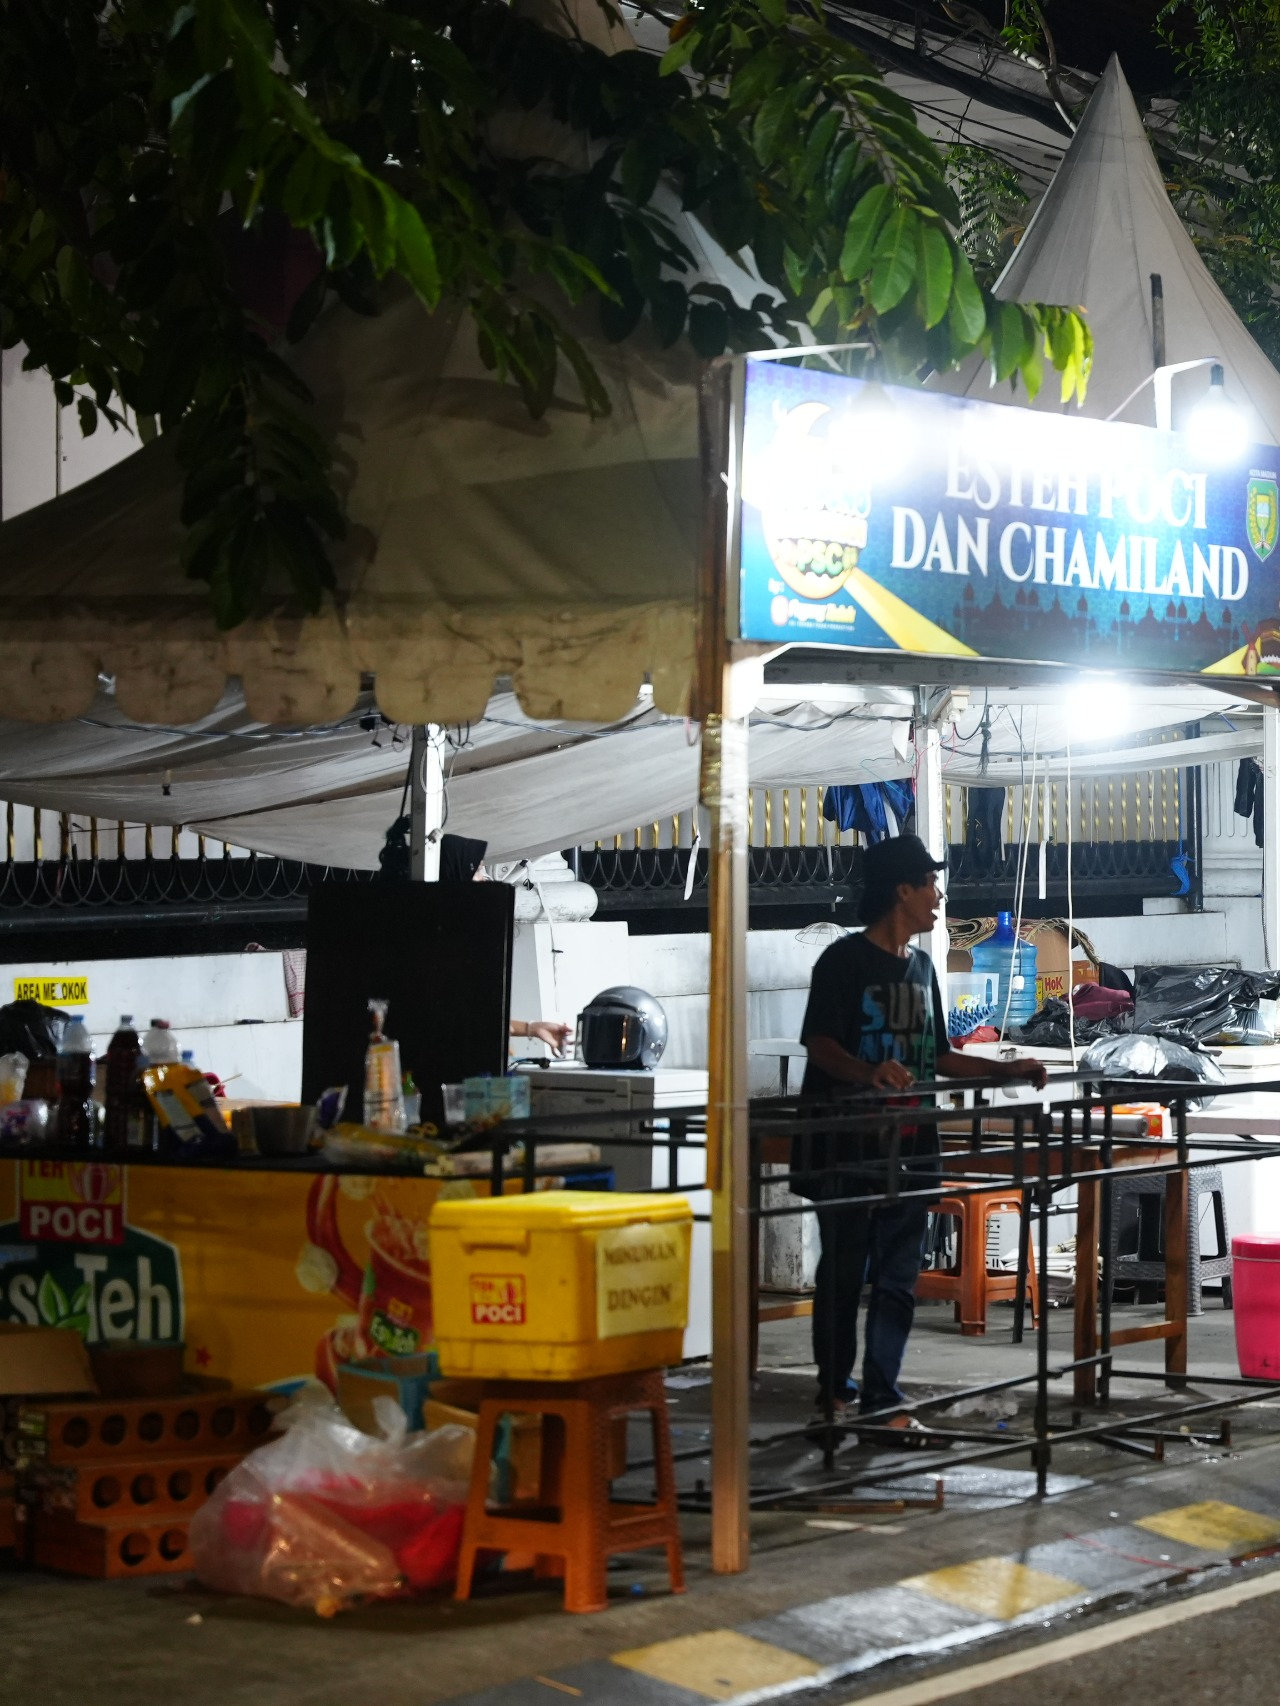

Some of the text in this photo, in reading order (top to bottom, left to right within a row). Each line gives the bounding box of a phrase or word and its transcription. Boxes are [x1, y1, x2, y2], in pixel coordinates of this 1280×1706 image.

[1098, 466, 1207, 529] POCI
[890, 506, 1249, 601] DAN CHAMILAND
[18, 982, 86, 1000] AREA MEOKOK
[29, 1205, 114, 1240] POCI
[475, 1304, 521, 1322] POCI
